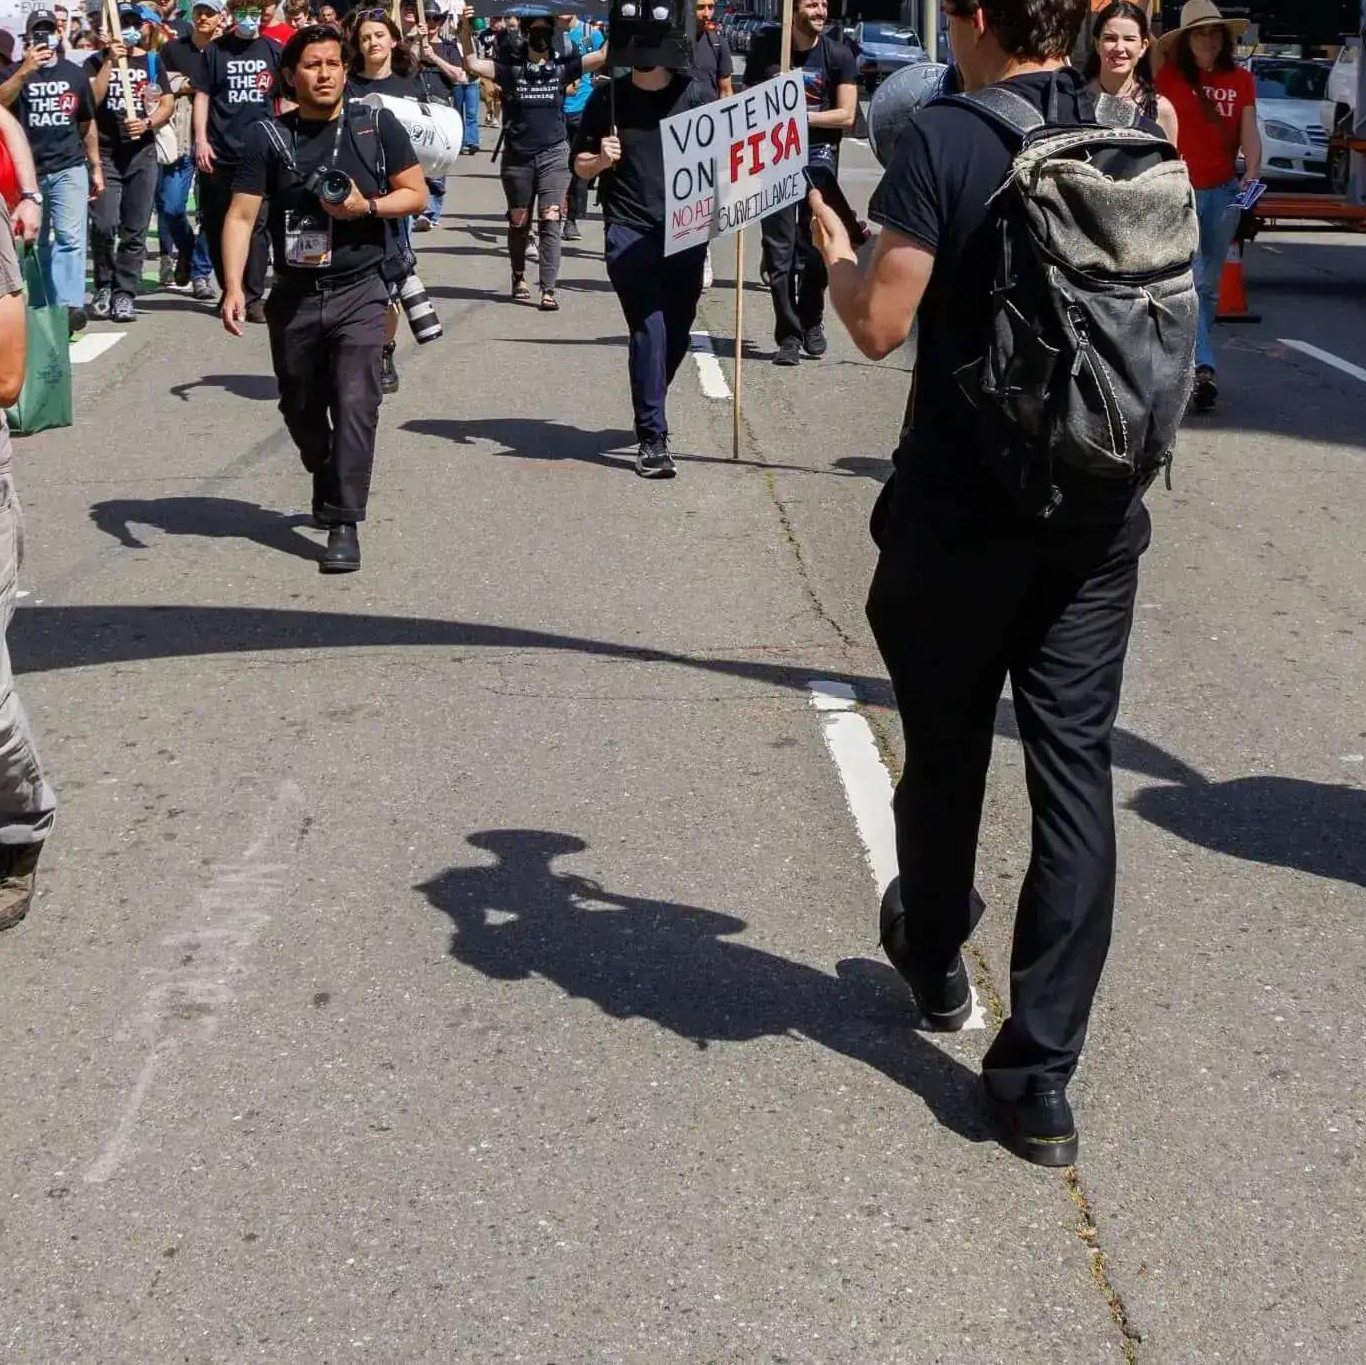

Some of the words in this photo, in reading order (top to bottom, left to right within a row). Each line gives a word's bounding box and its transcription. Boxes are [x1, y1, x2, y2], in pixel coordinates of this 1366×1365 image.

[226, 60, 267, 74] STOP
[28, 81, 70, 95] STOP
[227, 75, 257, 88] THE
[228, 89, 265, 103] RACE
[29, 98, 60, 111] THE
[29, 112, 71, 126] RACE
[669, 96, 758, 154] VOTE
[765, 80, 799, 120] NO
[673, 157, 716, 201] ON
[729, 117, 801, 183] FISA
[672, 205, 693, 230] NO
[695, 196, 714, 220] AI
[717, 172, 800, 232] SURVEILLANCE
